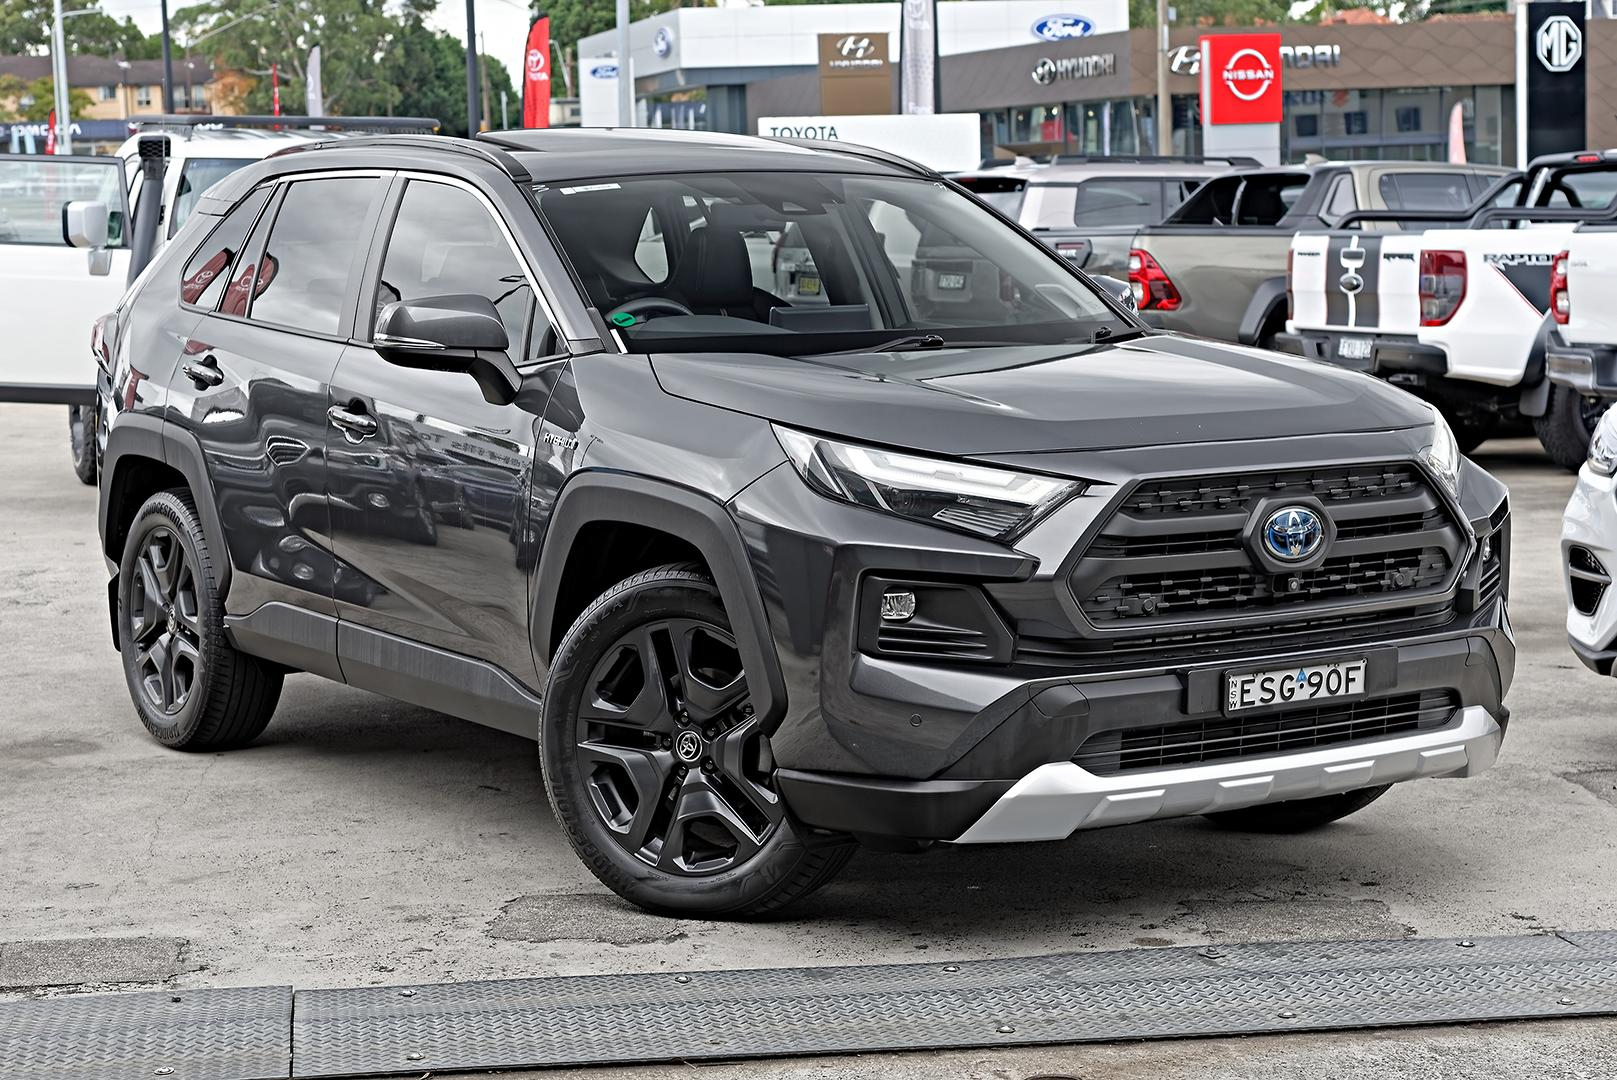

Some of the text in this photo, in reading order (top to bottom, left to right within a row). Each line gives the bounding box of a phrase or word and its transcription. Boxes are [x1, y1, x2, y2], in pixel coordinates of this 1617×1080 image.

[1541, 21, 1579, 67] MG
[1056, 54, 1116, 80] HYUNDAI
[1222, 70, 1274, 81] NISSAN
[770, 126, 839, 141] TOYOTA
[1483, 254, 1556, 266] RAPTO
